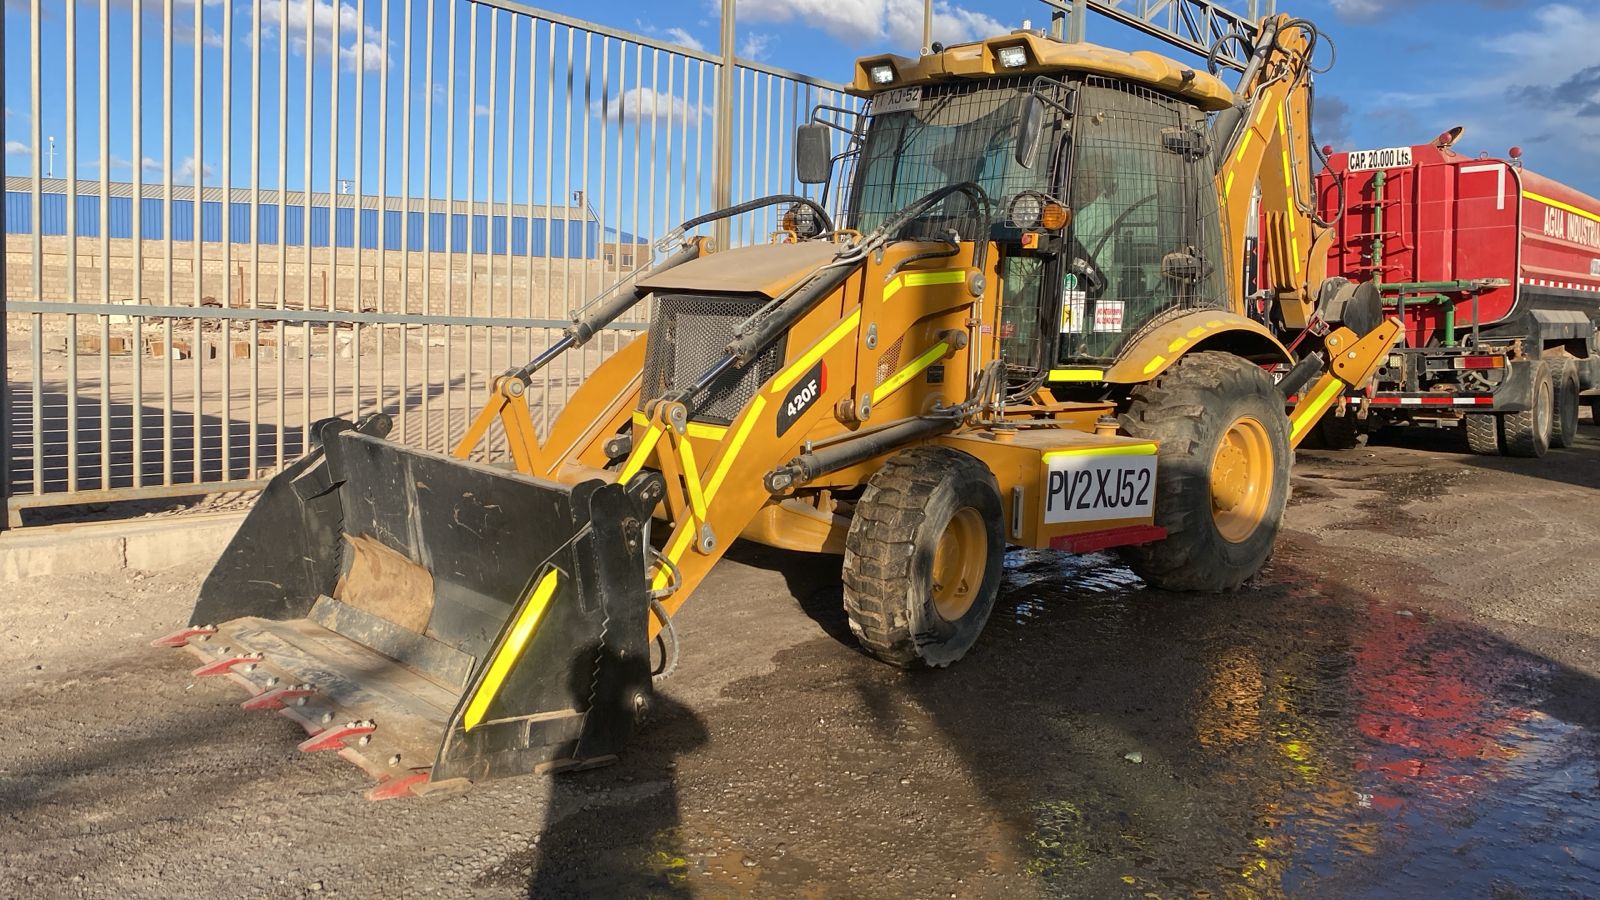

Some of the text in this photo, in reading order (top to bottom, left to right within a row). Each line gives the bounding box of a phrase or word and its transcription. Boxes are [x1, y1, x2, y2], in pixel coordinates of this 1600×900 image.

[1350, 148, 1411, 170] CAP. 20.000 Lts.
[1544, 205, 1566, 240] AGUA
[787, 379, 818, 416] 420F
[1047, 468, 1151, 512] PV2XJ52
